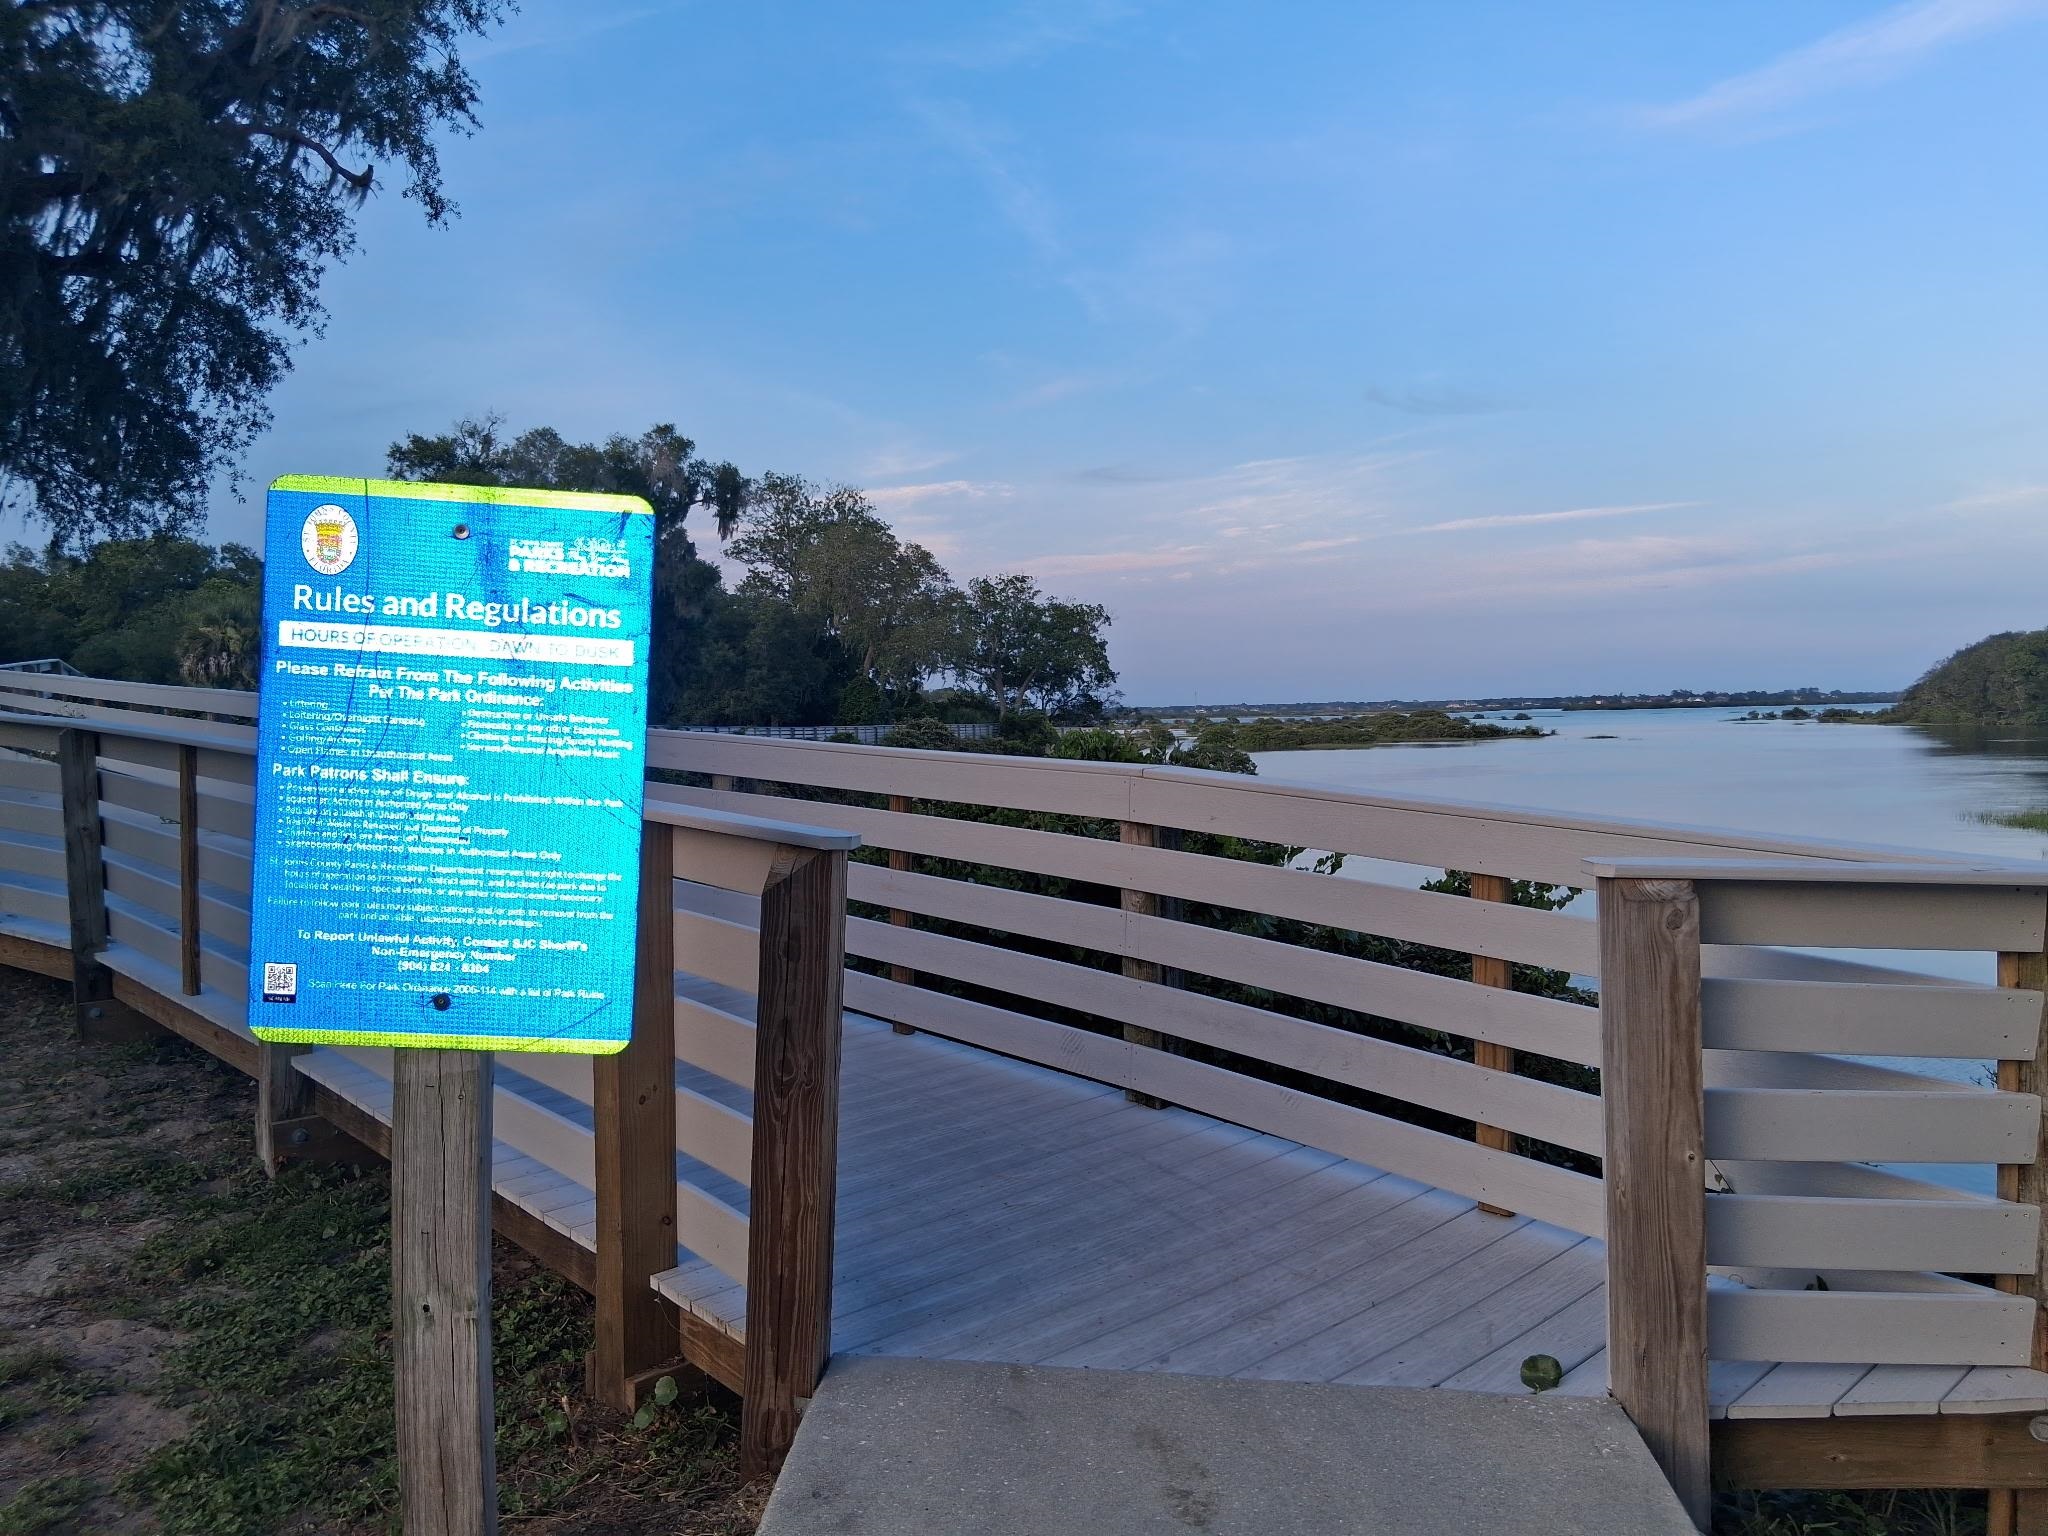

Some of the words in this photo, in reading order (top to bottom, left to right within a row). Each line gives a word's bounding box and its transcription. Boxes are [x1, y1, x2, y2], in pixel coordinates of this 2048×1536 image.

[293, 584, 375, 614] Rules
[382, 592, 438, 617] and
[445, 592, 622, 629] Regulations
[291, 627, 349, 644] HOURS
[354, 631, 375, 645] OF
[575, 644, 620, 658] DUSK
[276, 660, 329, 676] Please
[334, 663, 392, 680] Refrain
[396, 667, 439, 682] From
[443, 669, 473, 685] The
[477, 671, 555, 693] Following
[560, 676, 634, 693] Activities
[369, 684, 393, 698] Per
[398, 685, 424, 700] The
[428, 687, 461, 702] Park
[290, 700, 328, 710] Littering
[289, 722, 314, 731] Glass
[288, 745, 313, 755] Open
[272, 762, 306, 777] Park
[310, 764, 367, 780] Patrons
[372, 768, 409, 782] Shall
[297, 929, 310, 939] To
[314, 930, 355, 942] Report
[358, 932, 410, 944] Unlawful
[462, 936, 510, 948] Contact
[512, 938, 537, 949] SJC
[371, 946, 466, 961] Non-Emergency
[471, 950, 517, 962] Number
[397, 960, 427, 973] (904)
[308, 979, 332, 989] Scan
[360, 981, 376, 991] For
[378, 981, 400, 991] Park
